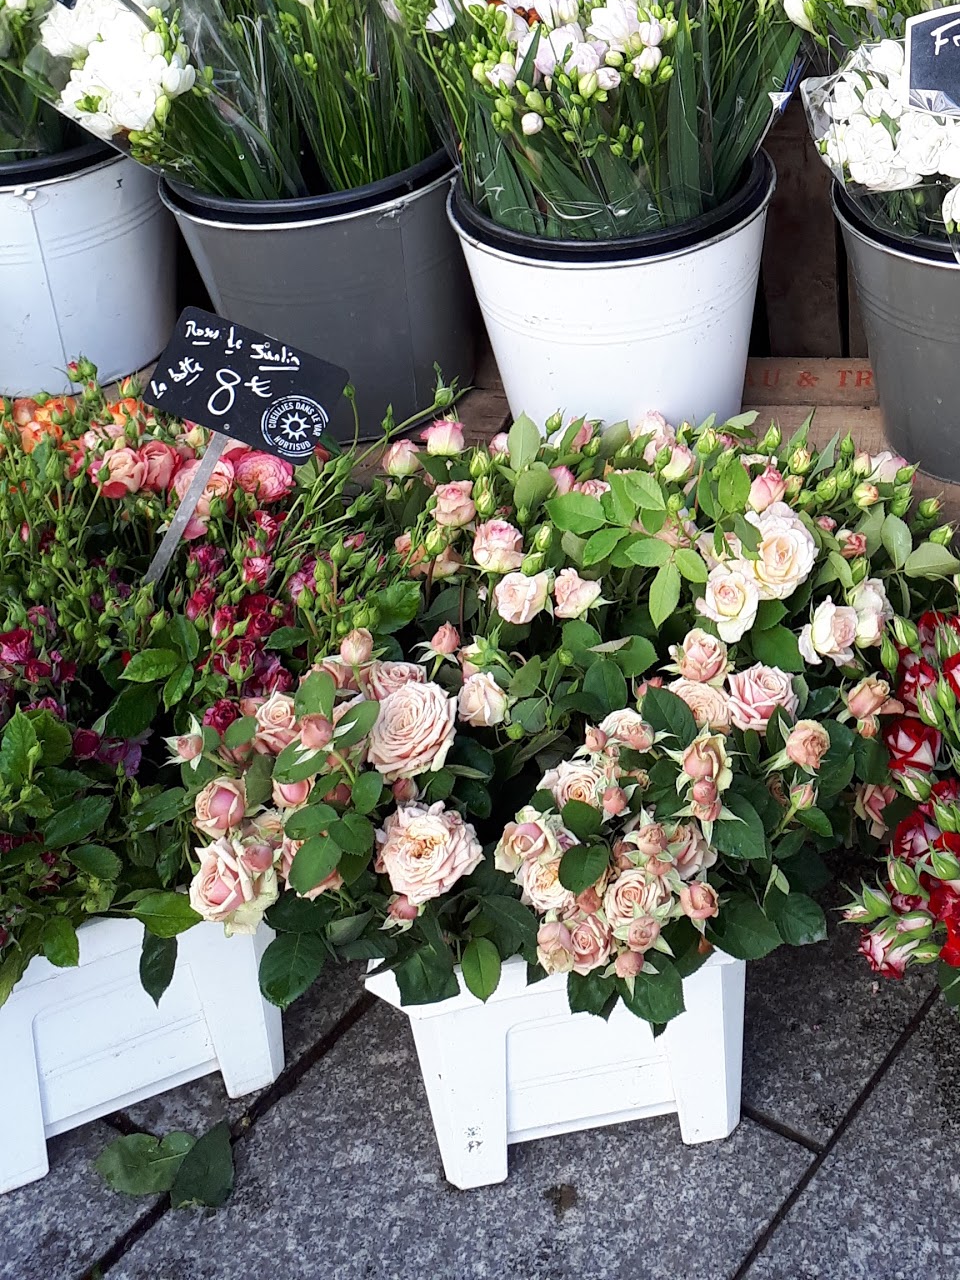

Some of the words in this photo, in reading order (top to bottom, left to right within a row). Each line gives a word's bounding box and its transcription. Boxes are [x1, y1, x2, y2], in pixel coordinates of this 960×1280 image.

[797, 371, 819, 387] &
[268, 402, 294, 429] CUEILLIES
[295, 402, 315, 416] DANS
[311, 413, 321, 423] LE
[312, 423, 323, 437] VAR
[273, 435, 311, 451] HORTISUD
